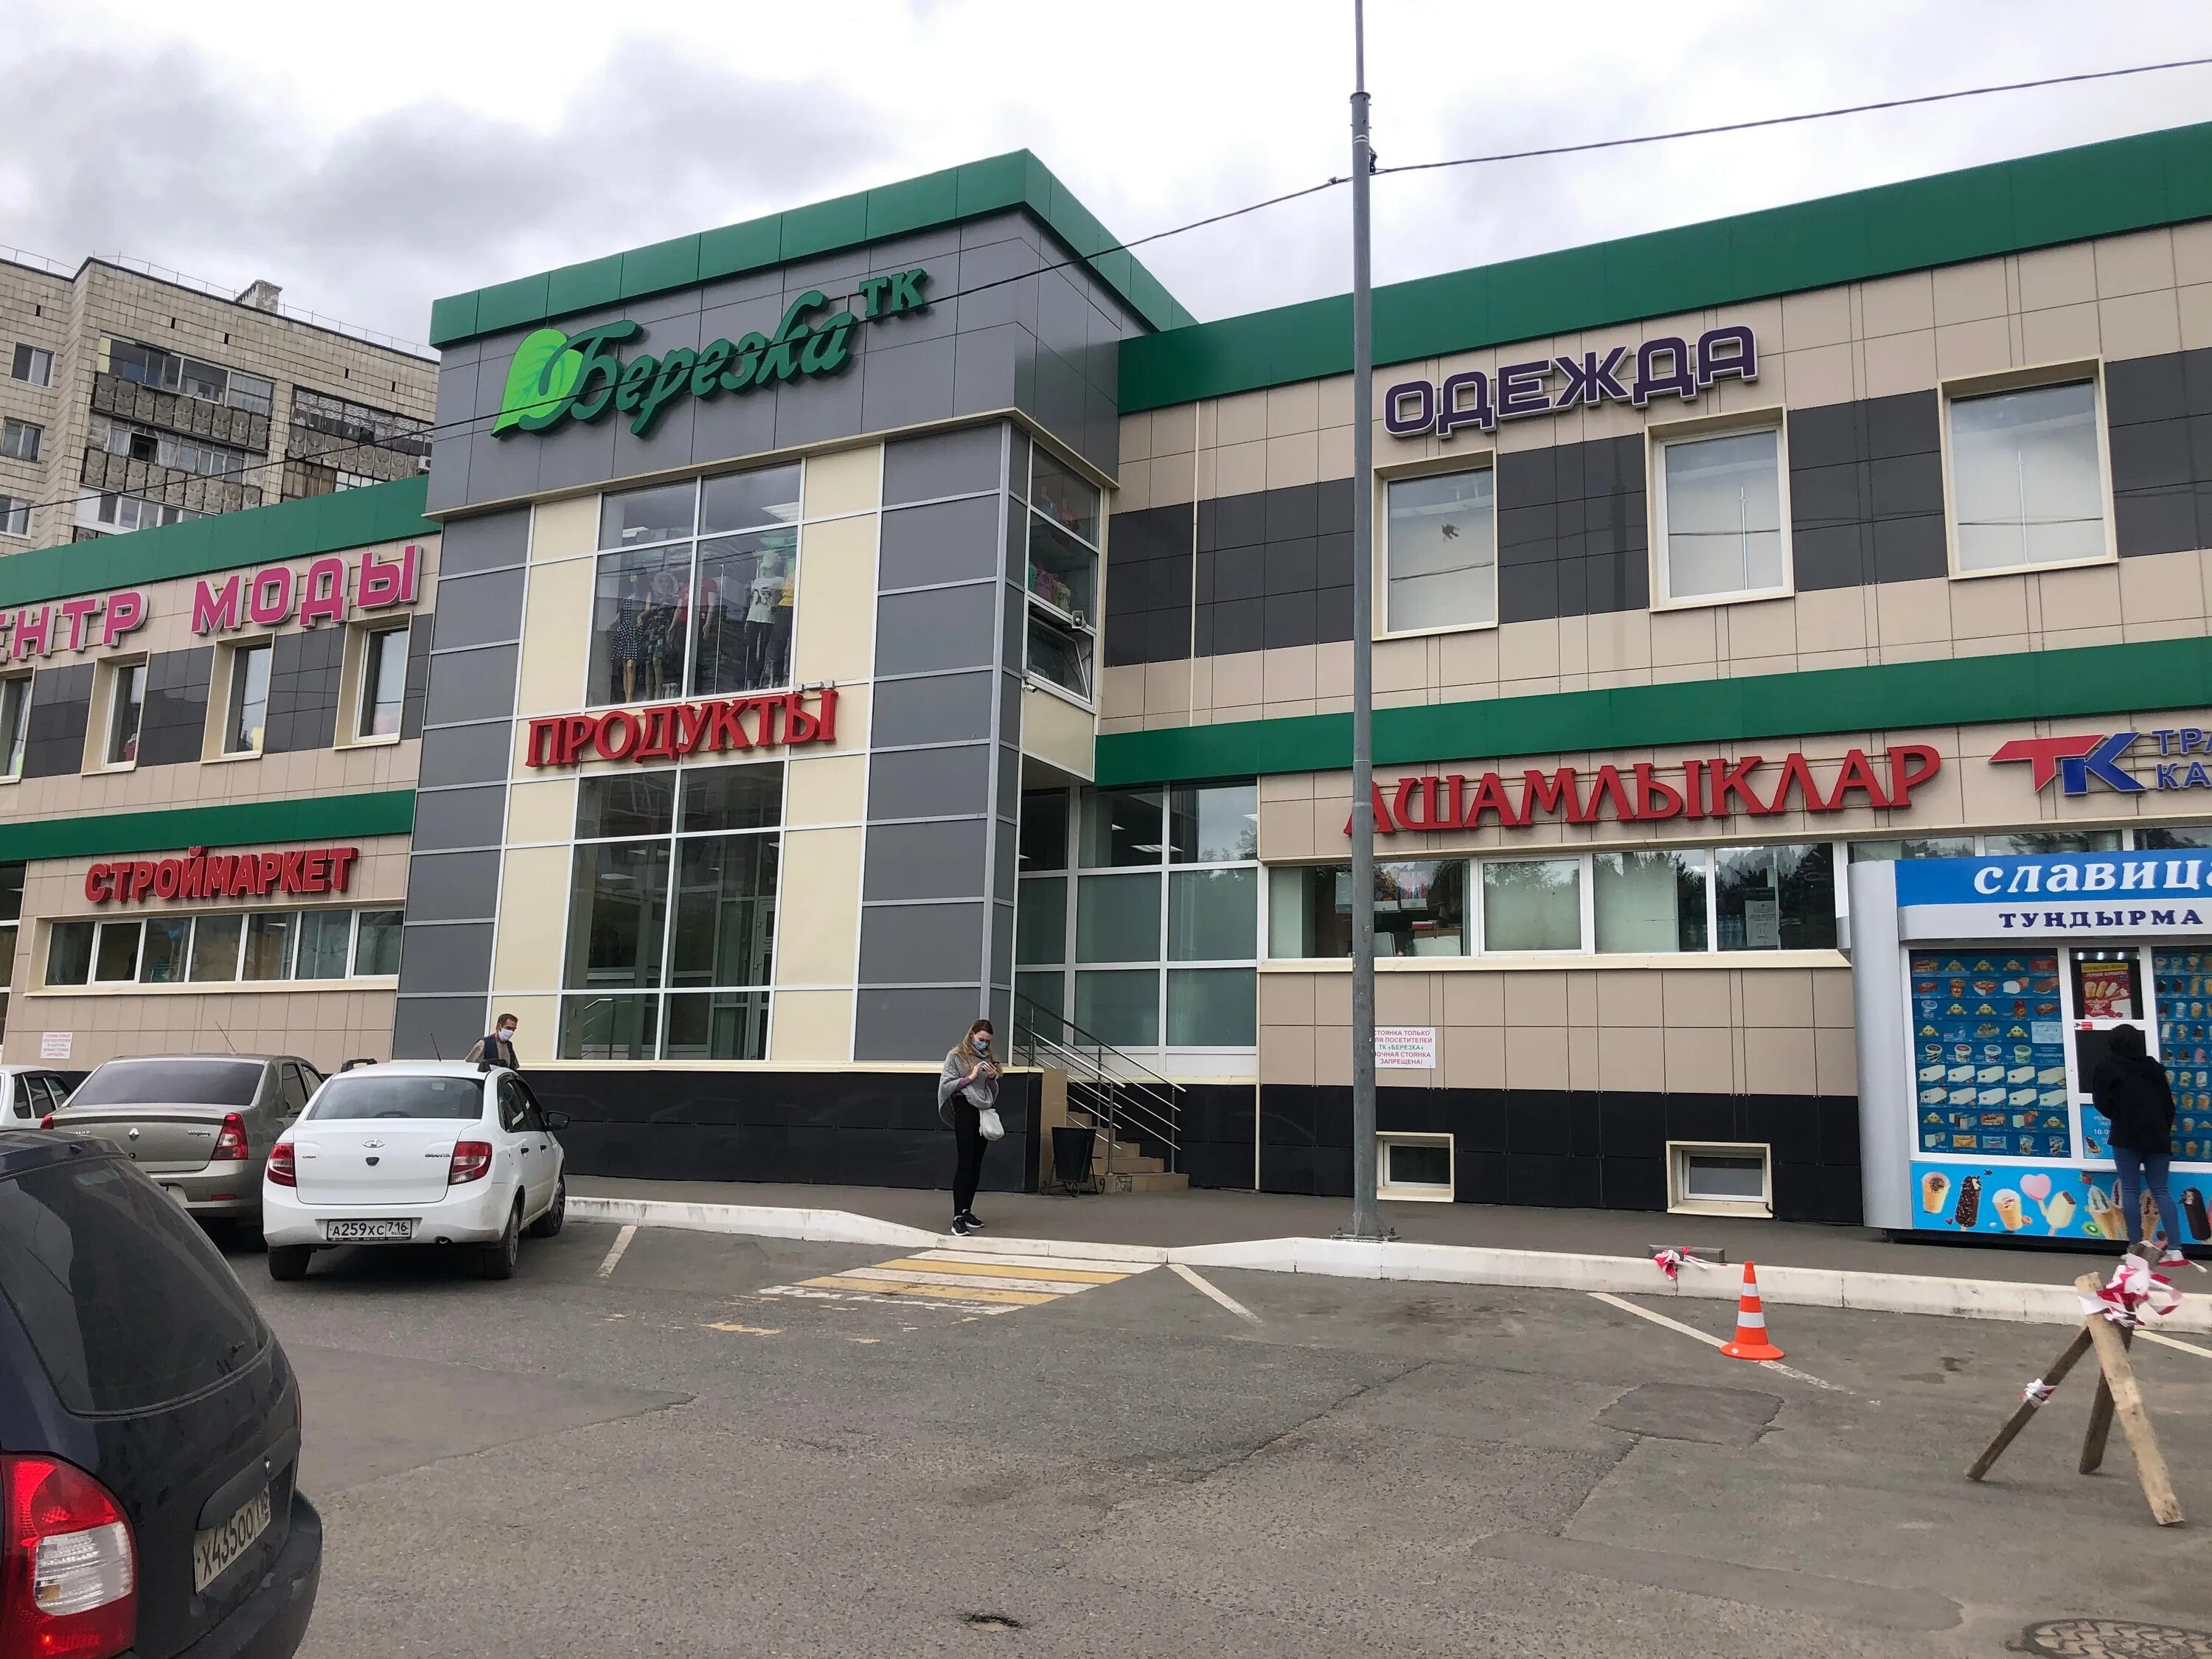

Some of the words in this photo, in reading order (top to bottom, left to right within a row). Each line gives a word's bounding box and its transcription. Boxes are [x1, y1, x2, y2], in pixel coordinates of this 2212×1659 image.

[518, 290, 858, 437] Березка
[859, 268, 928, 319] ТК
[1383, 325, 1759, 439] ОДЕЖДА
[0, 591, 148, 665] НТР
[191, 544, 423, 635] МОДЫ
[525, 689, 839, 768] ПРОДУКТЫ
[1987, 731, 2147, 796] ТК
[85, 846, 358, 904] СТРОЙМАРКЕТ
[1973, 860, 2212, 895] славиц
[332, 1222, 385, 1236] А259ХС
[387, 1222, 407, 1232] 716
